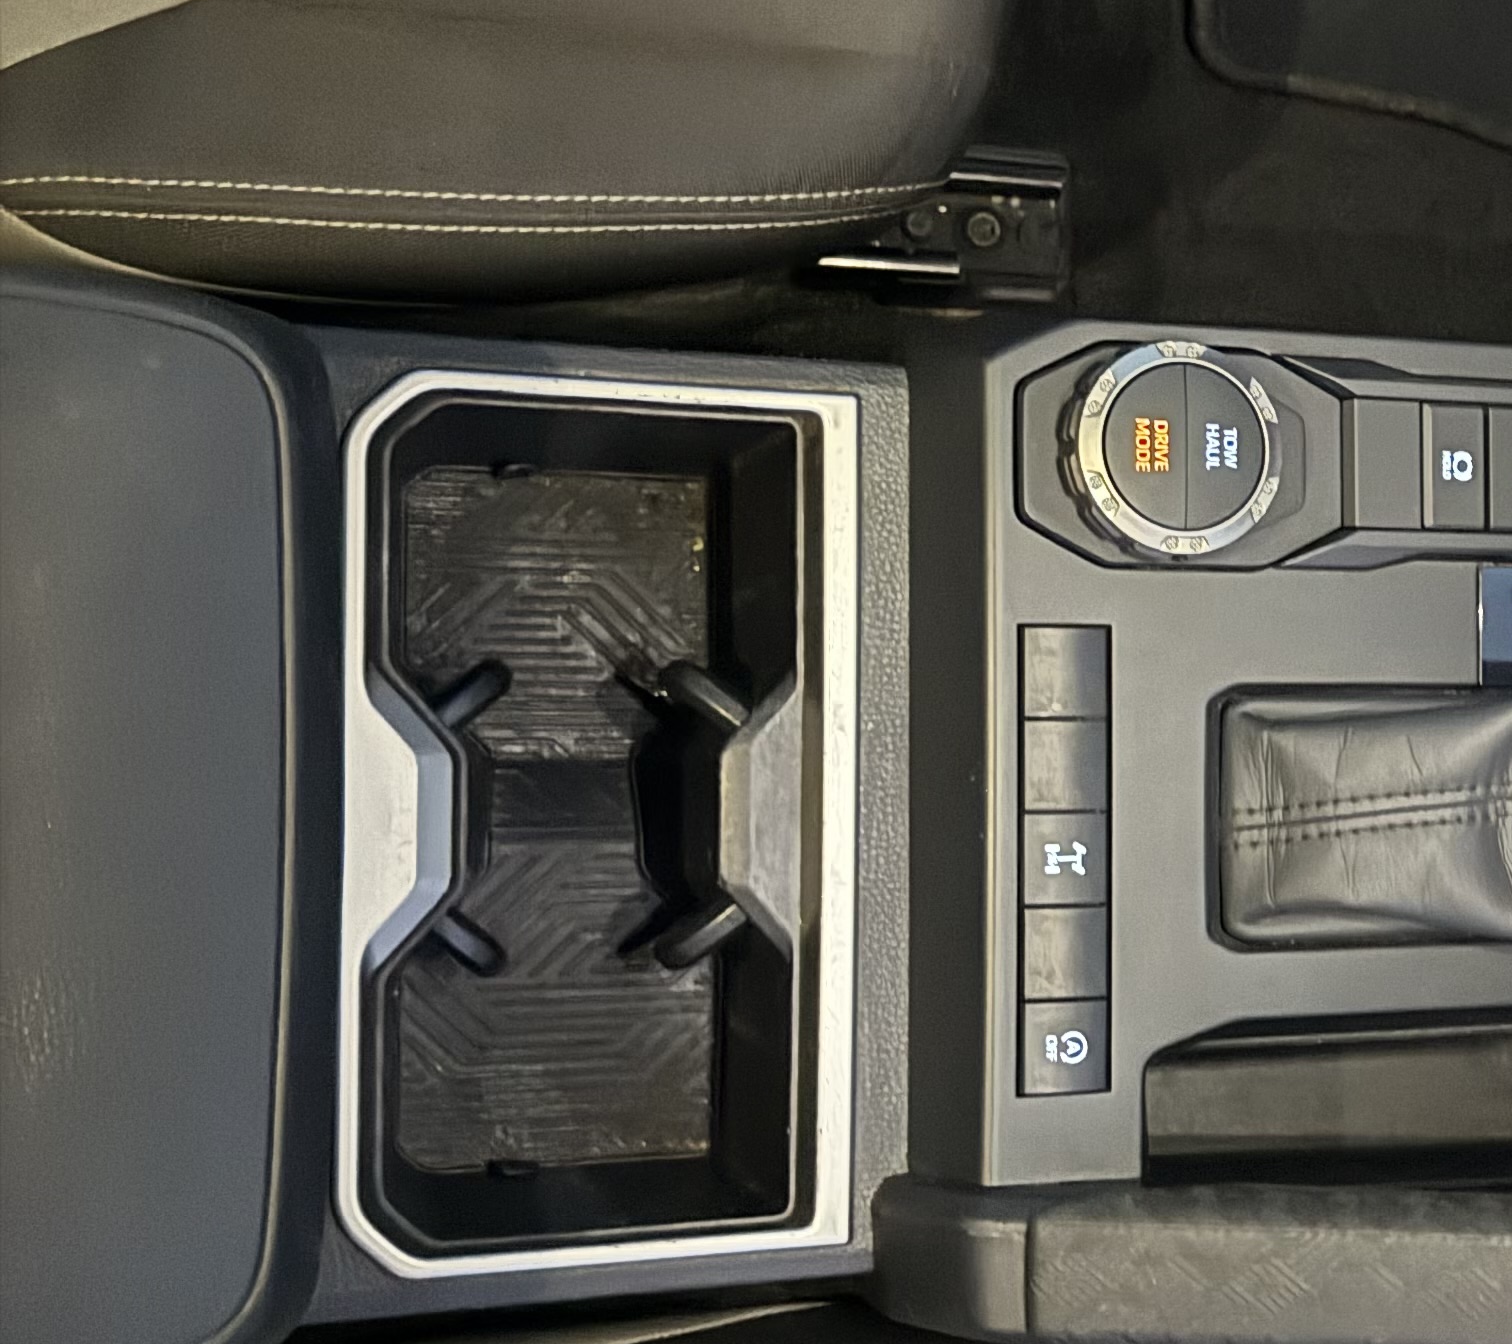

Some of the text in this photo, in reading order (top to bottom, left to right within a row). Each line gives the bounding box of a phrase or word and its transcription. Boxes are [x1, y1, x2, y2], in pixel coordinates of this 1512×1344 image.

[1135, 417, 1151, 473] MODE
[1153, 419, 1169, 472] DRIVE
[1205, 423, 1220, 471] HAUL
[1222, 426, 1238, 469] TOW
[1045, 1034, 1058, 1062] OFF
